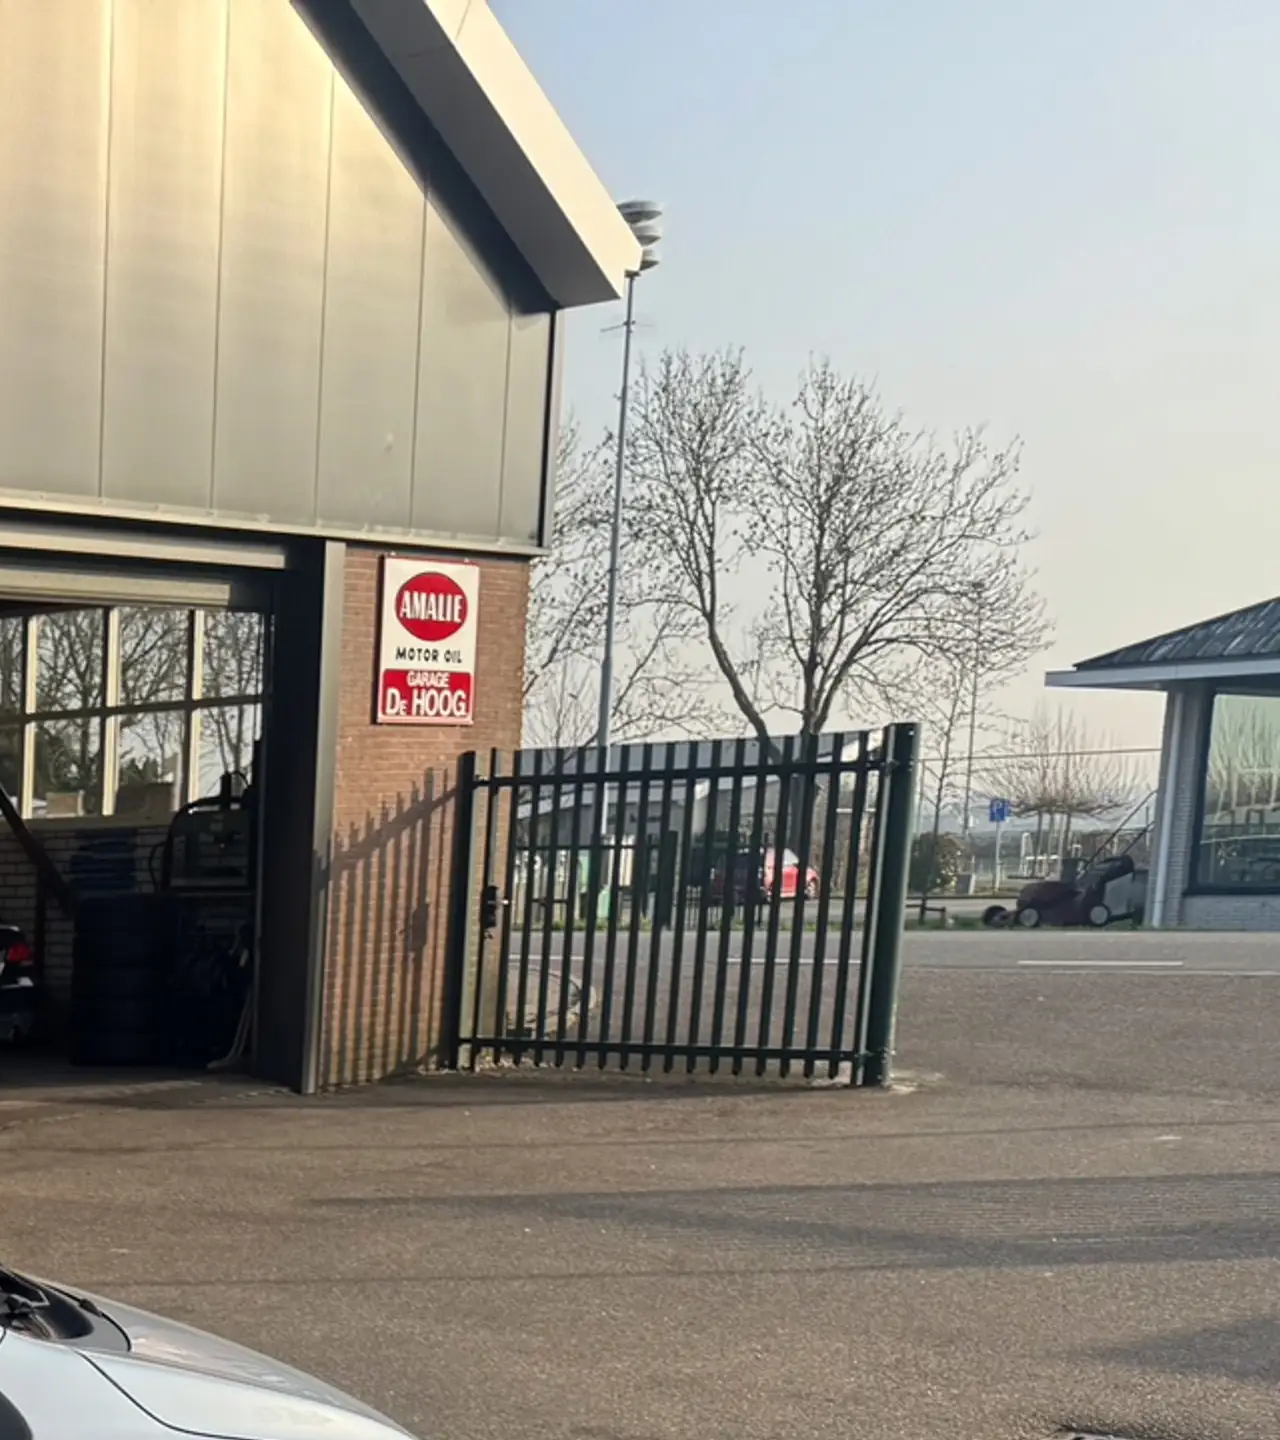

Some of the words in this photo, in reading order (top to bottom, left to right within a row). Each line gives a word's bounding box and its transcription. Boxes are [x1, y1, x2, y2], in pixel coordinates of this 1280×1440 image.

[399, 590, 463, 624] AMALIE
[395, 647, 439, 663] MOTOR
[443, 649, 462, 664] OIL
[406, 670, 450, 687] GARAGE
[412, 688, 466, 717] HOOG
